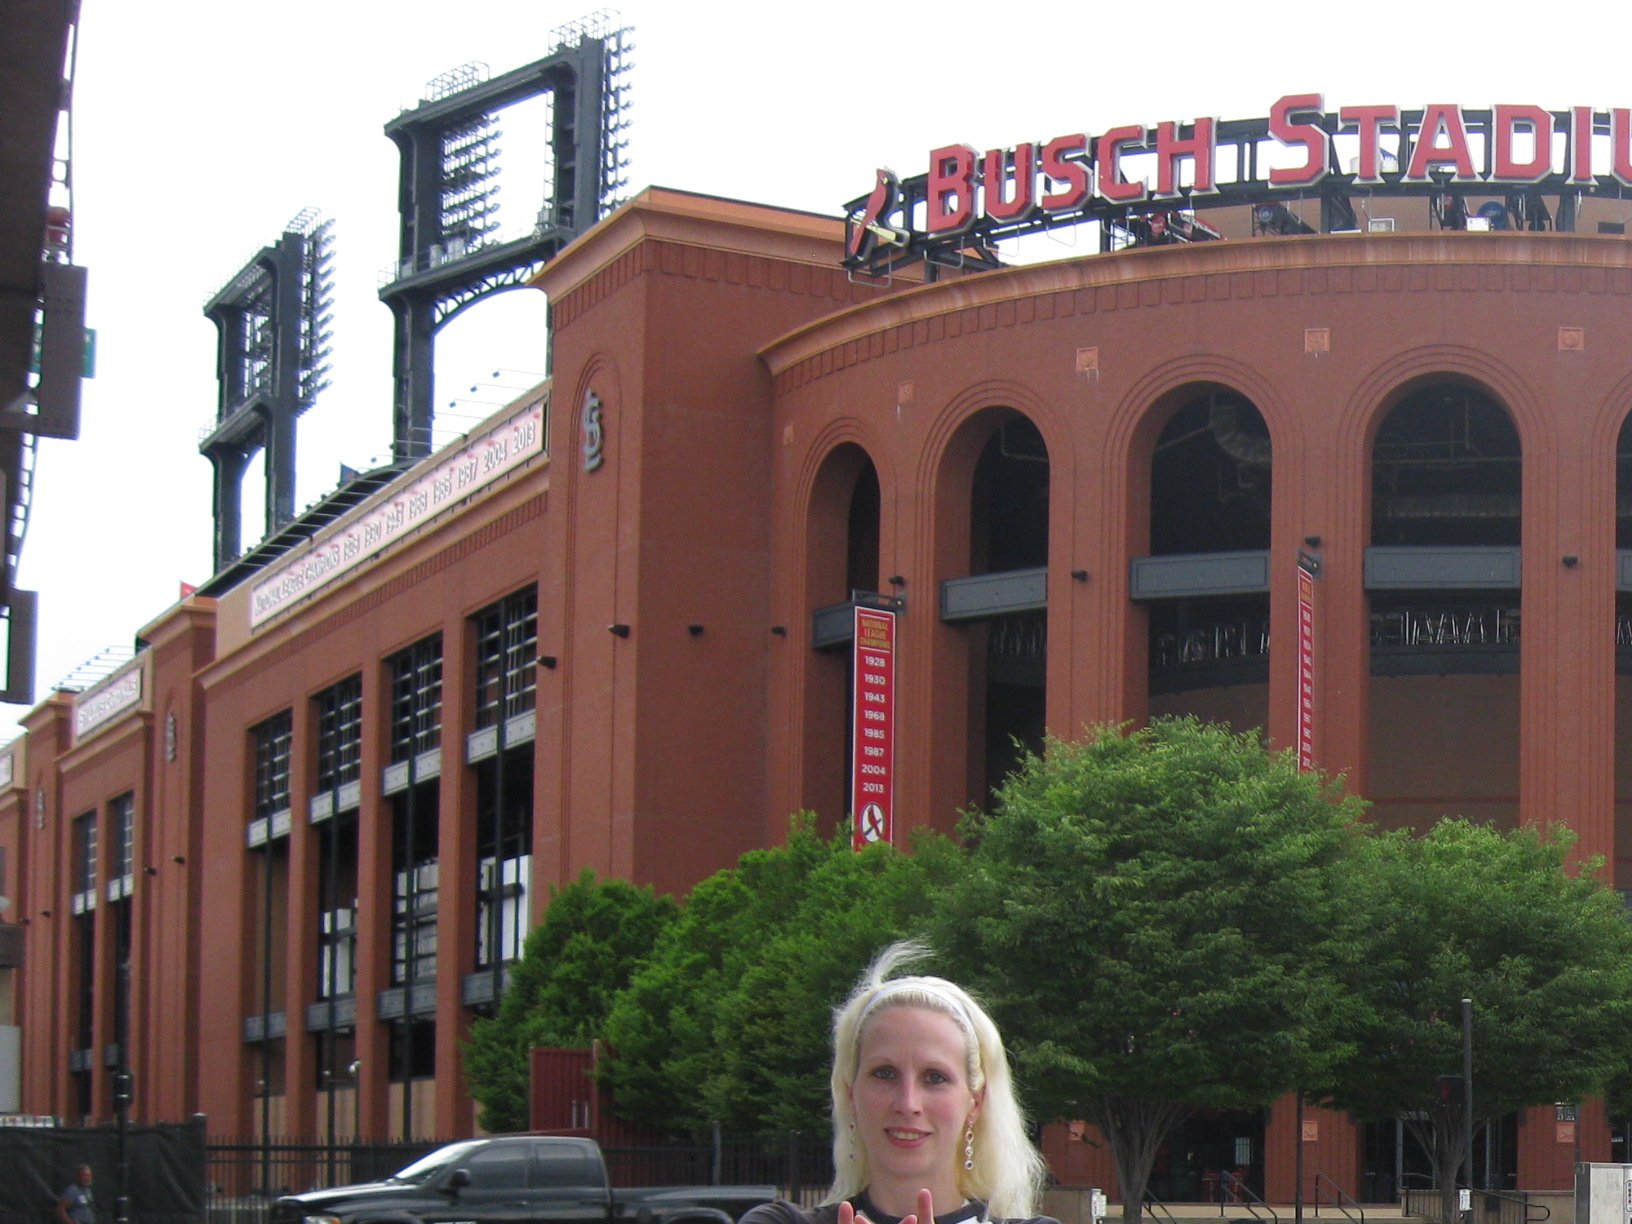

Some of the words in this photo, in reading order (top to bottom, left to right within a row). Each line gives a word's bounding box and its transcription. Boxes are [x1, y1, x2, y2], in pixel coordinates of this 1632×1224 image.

[926, 116, 1220, 236] BUSCH
[511, 420, 537, 456] 2013
[861, 763, 887, 776] 2004
[862, 781, 885, 794] 2013
